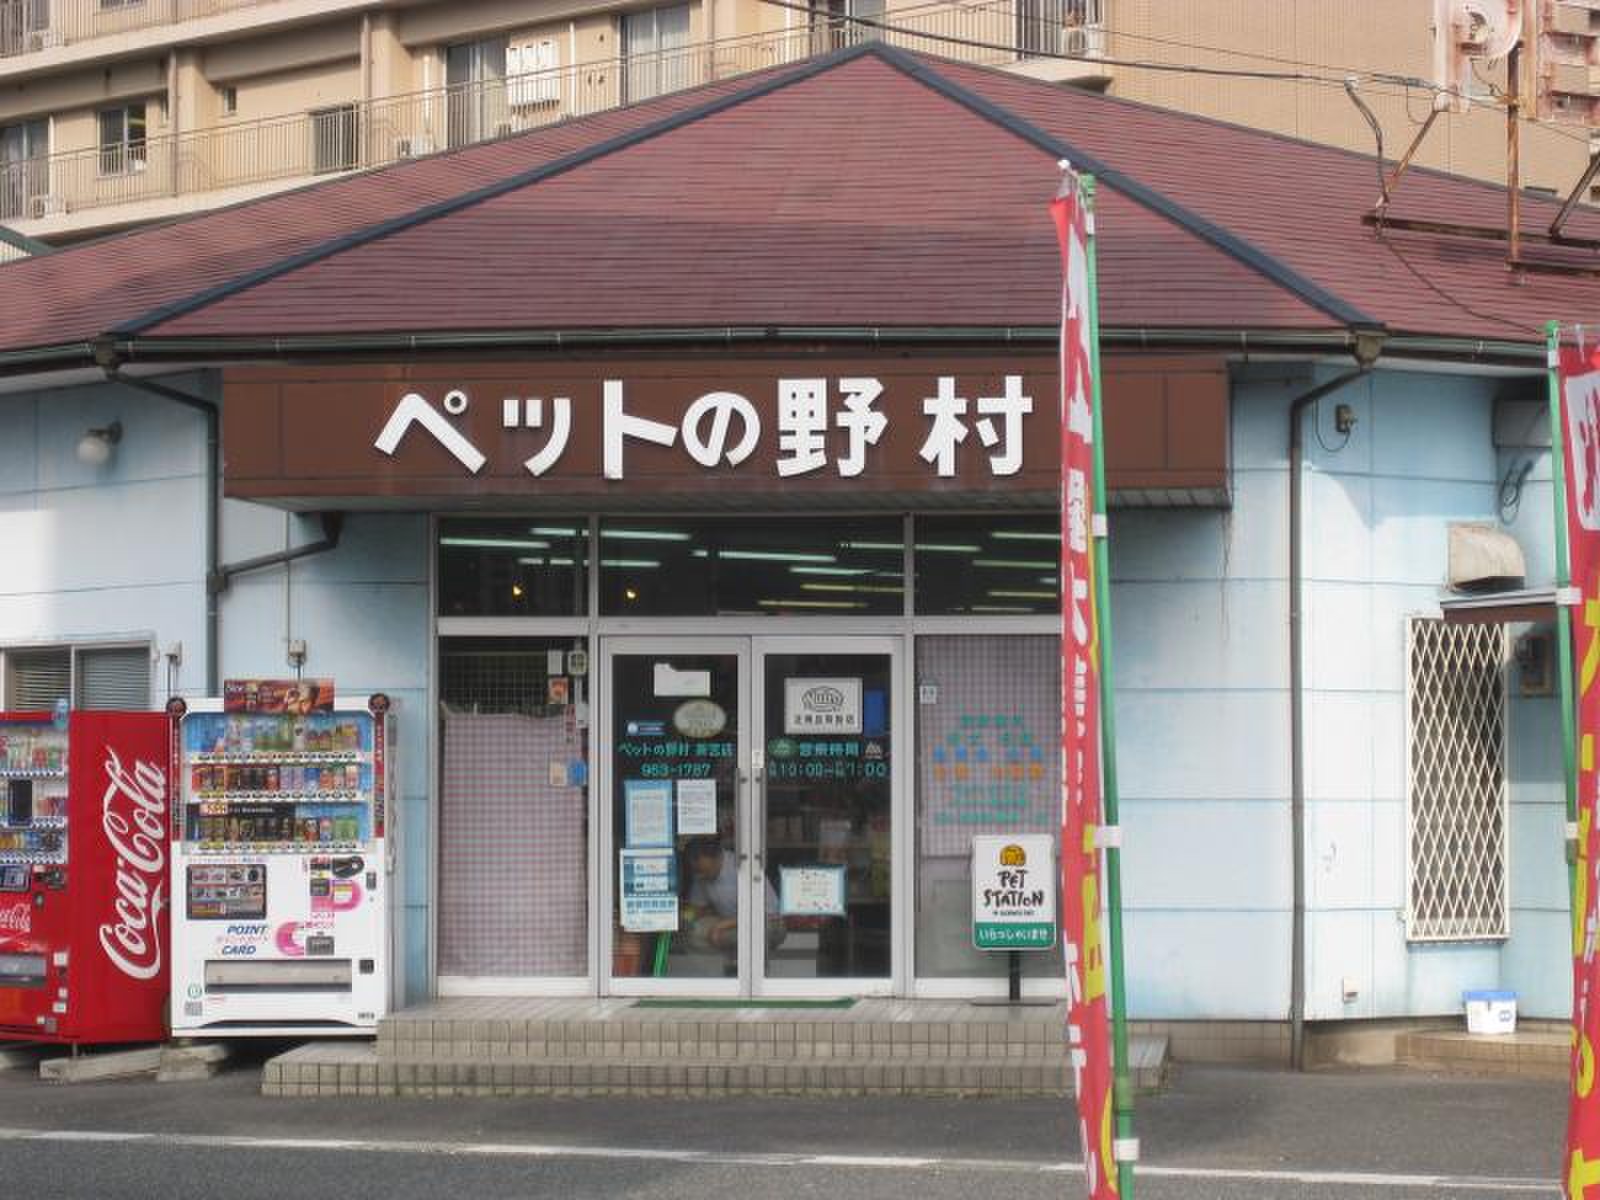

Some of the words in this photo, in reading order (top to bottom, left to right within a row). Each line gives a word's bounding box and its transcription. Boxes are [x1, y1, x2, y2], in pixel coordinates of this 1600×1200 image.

[375, 375, 1033, 479] ペットの野村
[99, 744, 165, 980] Coca-Cola
[997, 869, 1028, 889] PET
[983, 889, 1044, 907] STATION
[226, 924, 269, 935] POINT
[221, 944, 257, 956] CARD
